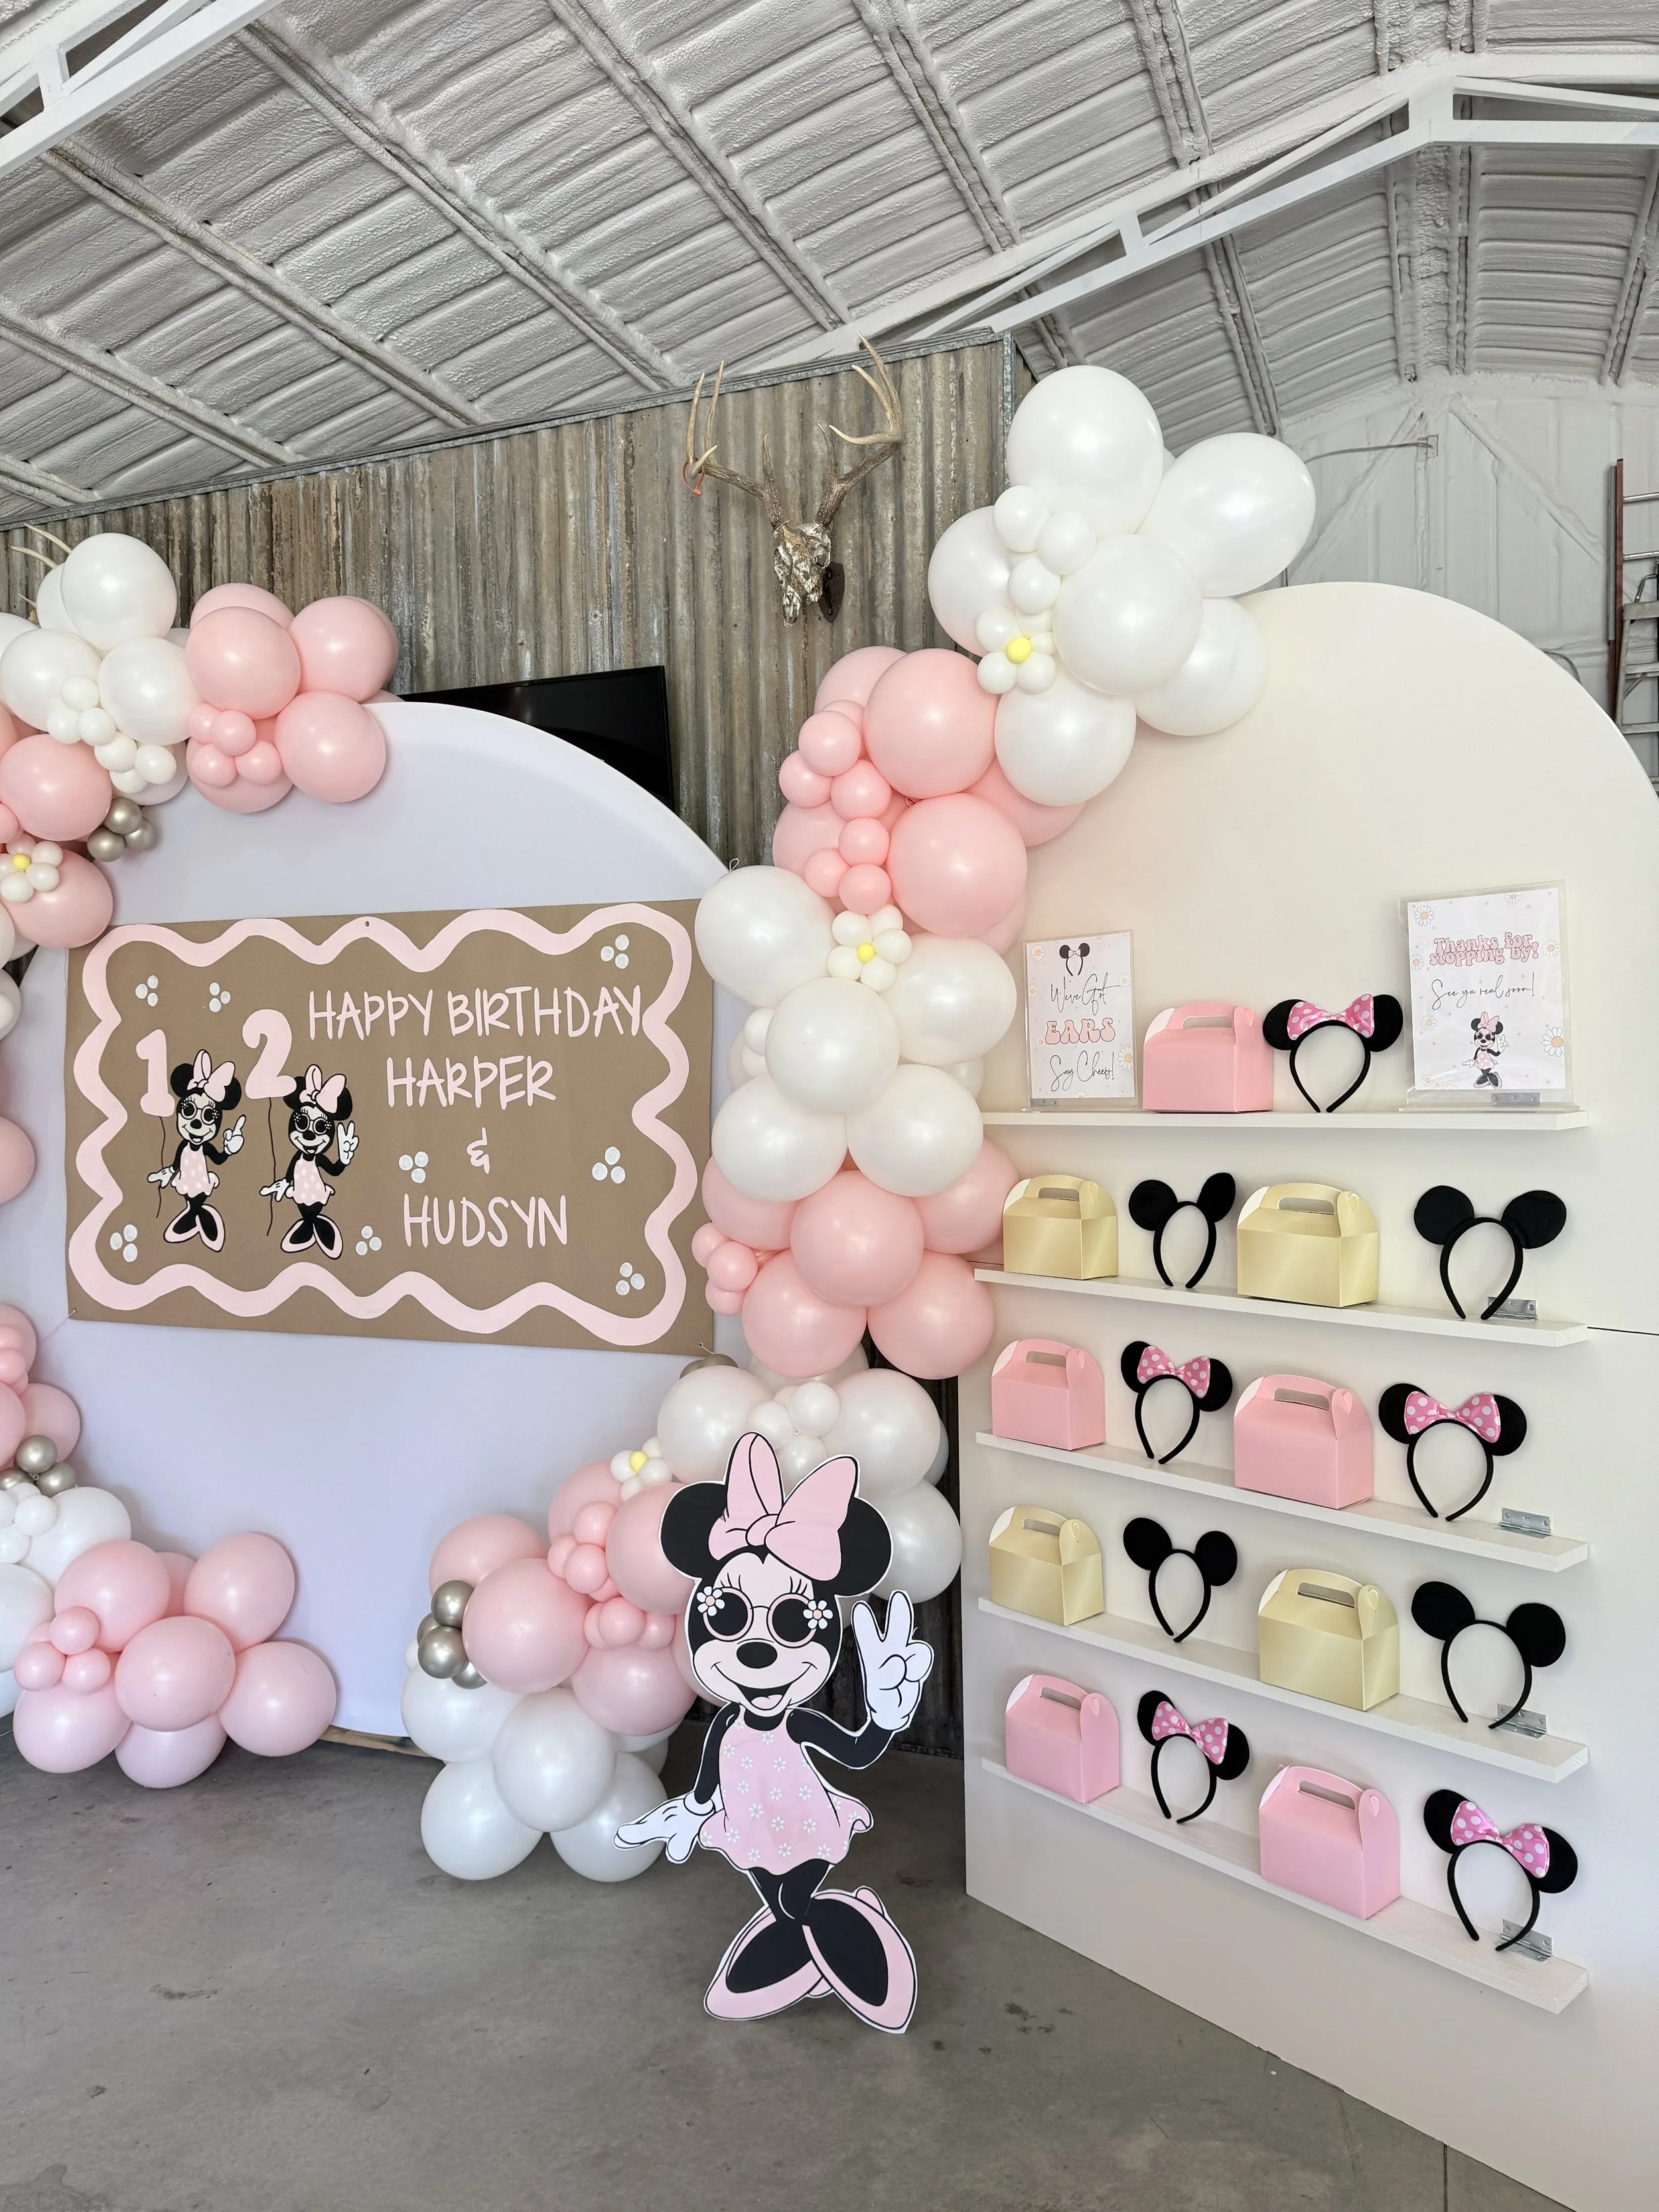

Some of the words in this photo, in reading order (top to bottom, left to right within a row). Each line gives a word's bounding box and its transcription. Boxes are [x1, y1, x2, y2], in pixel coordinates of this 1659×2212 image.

[1429, 947, 1505, 967] stopping
[1510, 941, 1540, 962] by!
[1433, 934, 1499, 954] Thanks
[1504, 932, 1533, 949] for
[308, 989, 433, 1041] HAPPY
[447, 984, 641, 1038] BIRTHDAY
[1050, 976, 1082, 1013] We've
[1082, 972, 1121, 1016] Got
[1431, 979, 1459, 1011] See
[1456, 988, 1477, 1009] ya
[1479, 974, 1504, 999] real
[1504, 972, 1535, 997] soon!
[1045, 1017, 1116, 1045] EARS
[136, 1029, 175, 1117] 1
[242, 1009, 297, 1100] 2
[1049, 1055, 1076, 1092] Say
[386, 1055, 557, 1111] HARPER
[465, 1126, 491, 1175] &
[403, 1193, 567, 1249] HUDSYN
